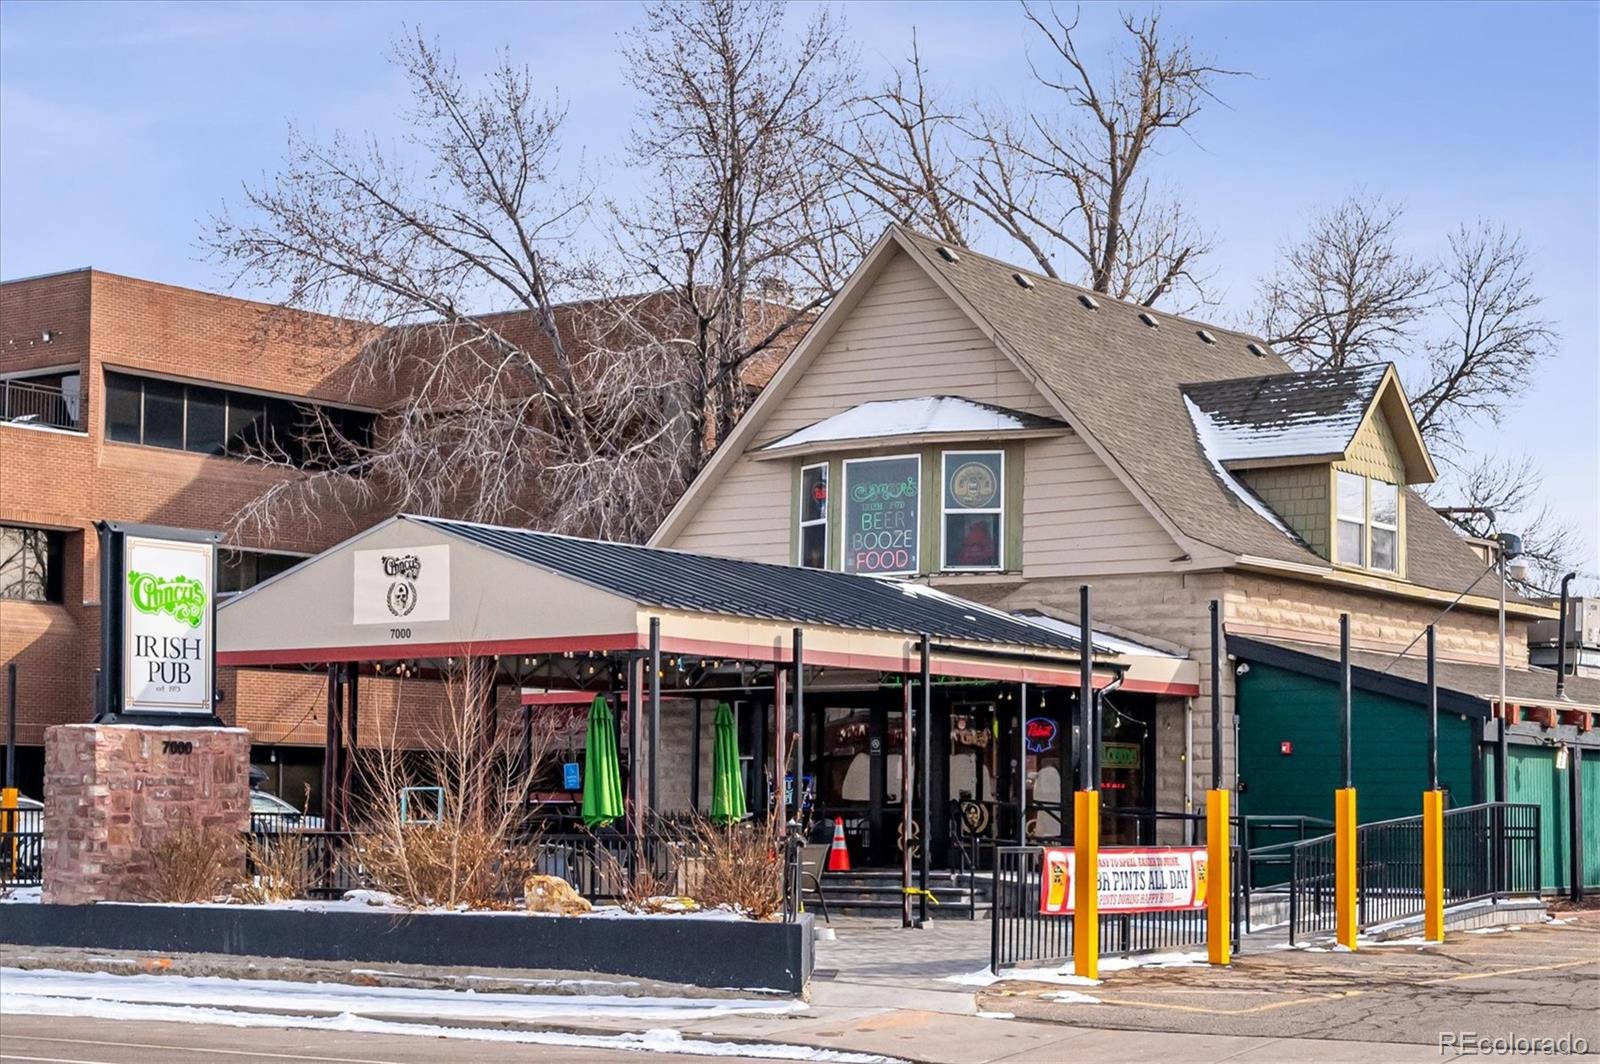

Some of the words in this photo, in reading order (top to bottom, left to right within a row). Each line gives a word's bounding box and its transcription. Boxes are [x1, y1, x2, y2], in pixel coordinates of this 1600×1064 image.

[861, 512, 905, 531] BEER
[852, 530, 912, 551] BOOZE
[856, 550, 908, 570] FOOD
[390, 628, 412, 639] 7000
[135, 634, 202, 660] IRISH
[147, 660, 192, 684] PUB
[162, 740, 193, 755] 7000
[1097, 872, 1111, 892] BR
[1112, 871, 1146, 891] PINTS
[1148, 870, 1168, 890] ALL
[1169, 870, 1188, 889] DAY
